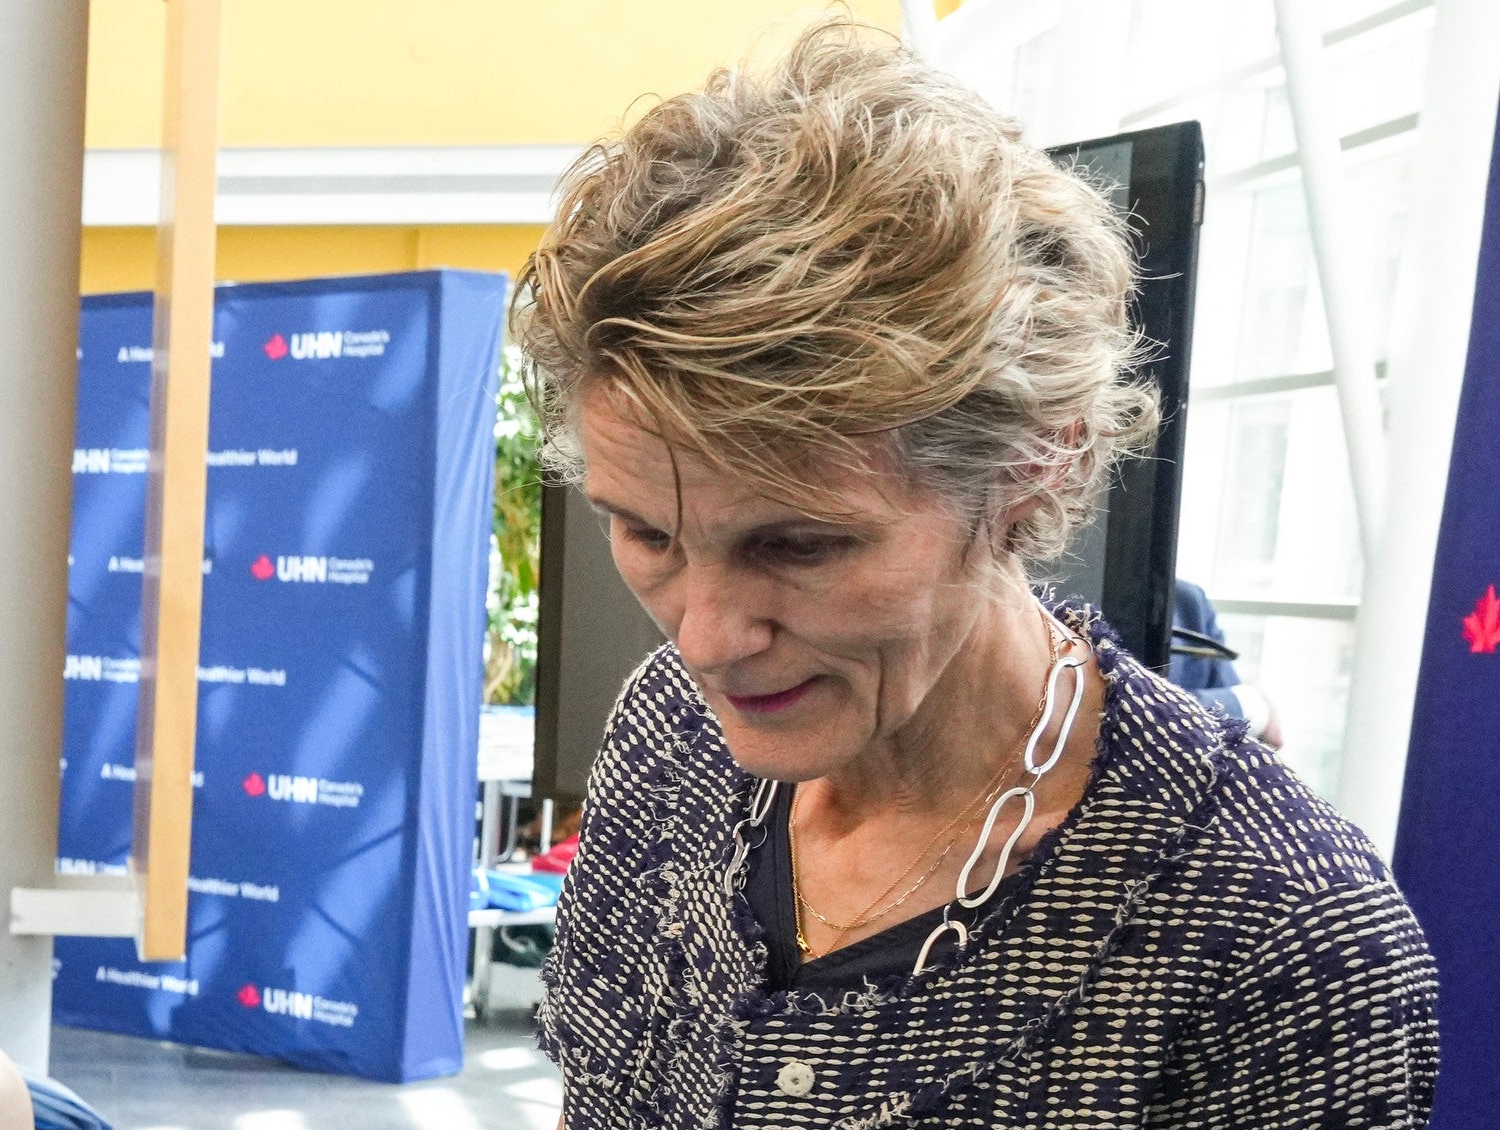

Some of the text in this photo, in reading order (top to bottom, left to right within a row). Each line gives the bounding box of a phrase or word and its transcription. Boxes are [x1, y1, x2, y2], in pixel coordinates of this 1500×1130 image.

[290, 331, 343, 359] UHN
[206, 447, 298, 466] ealthier World
[276, 555, 328, 582] UHN
[196, 665, 287, 686] ealthier World
[267, 773, 318, 804] UHN
[240, 881, 279, 902] World
[263, 987, 313, 1020] UHN
